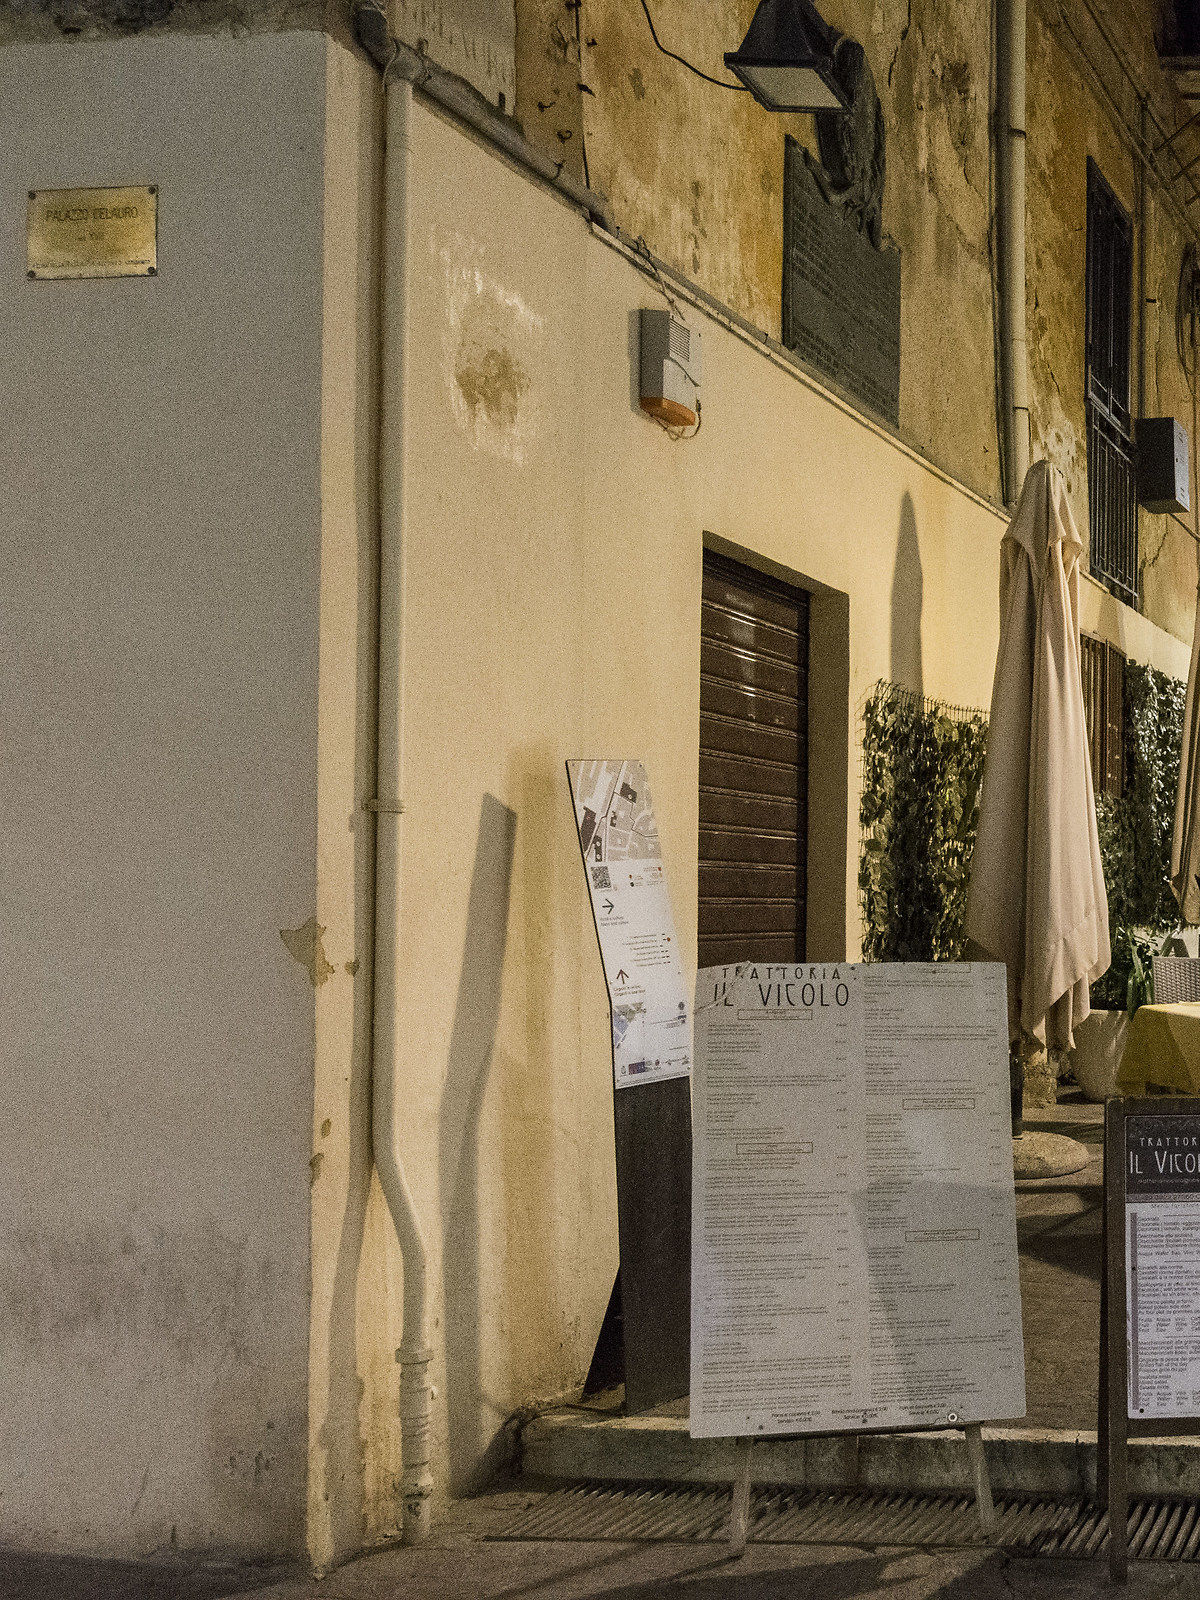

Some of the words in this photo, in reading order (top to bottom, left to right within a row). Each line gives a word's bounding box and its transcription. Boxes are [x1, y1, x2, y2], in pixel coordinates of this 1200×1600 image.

[722, 966, 841, 980] TRATTORIA
[714, 982, 734, 1006] IL
[758, 983, 850, 1006] VICOLO
